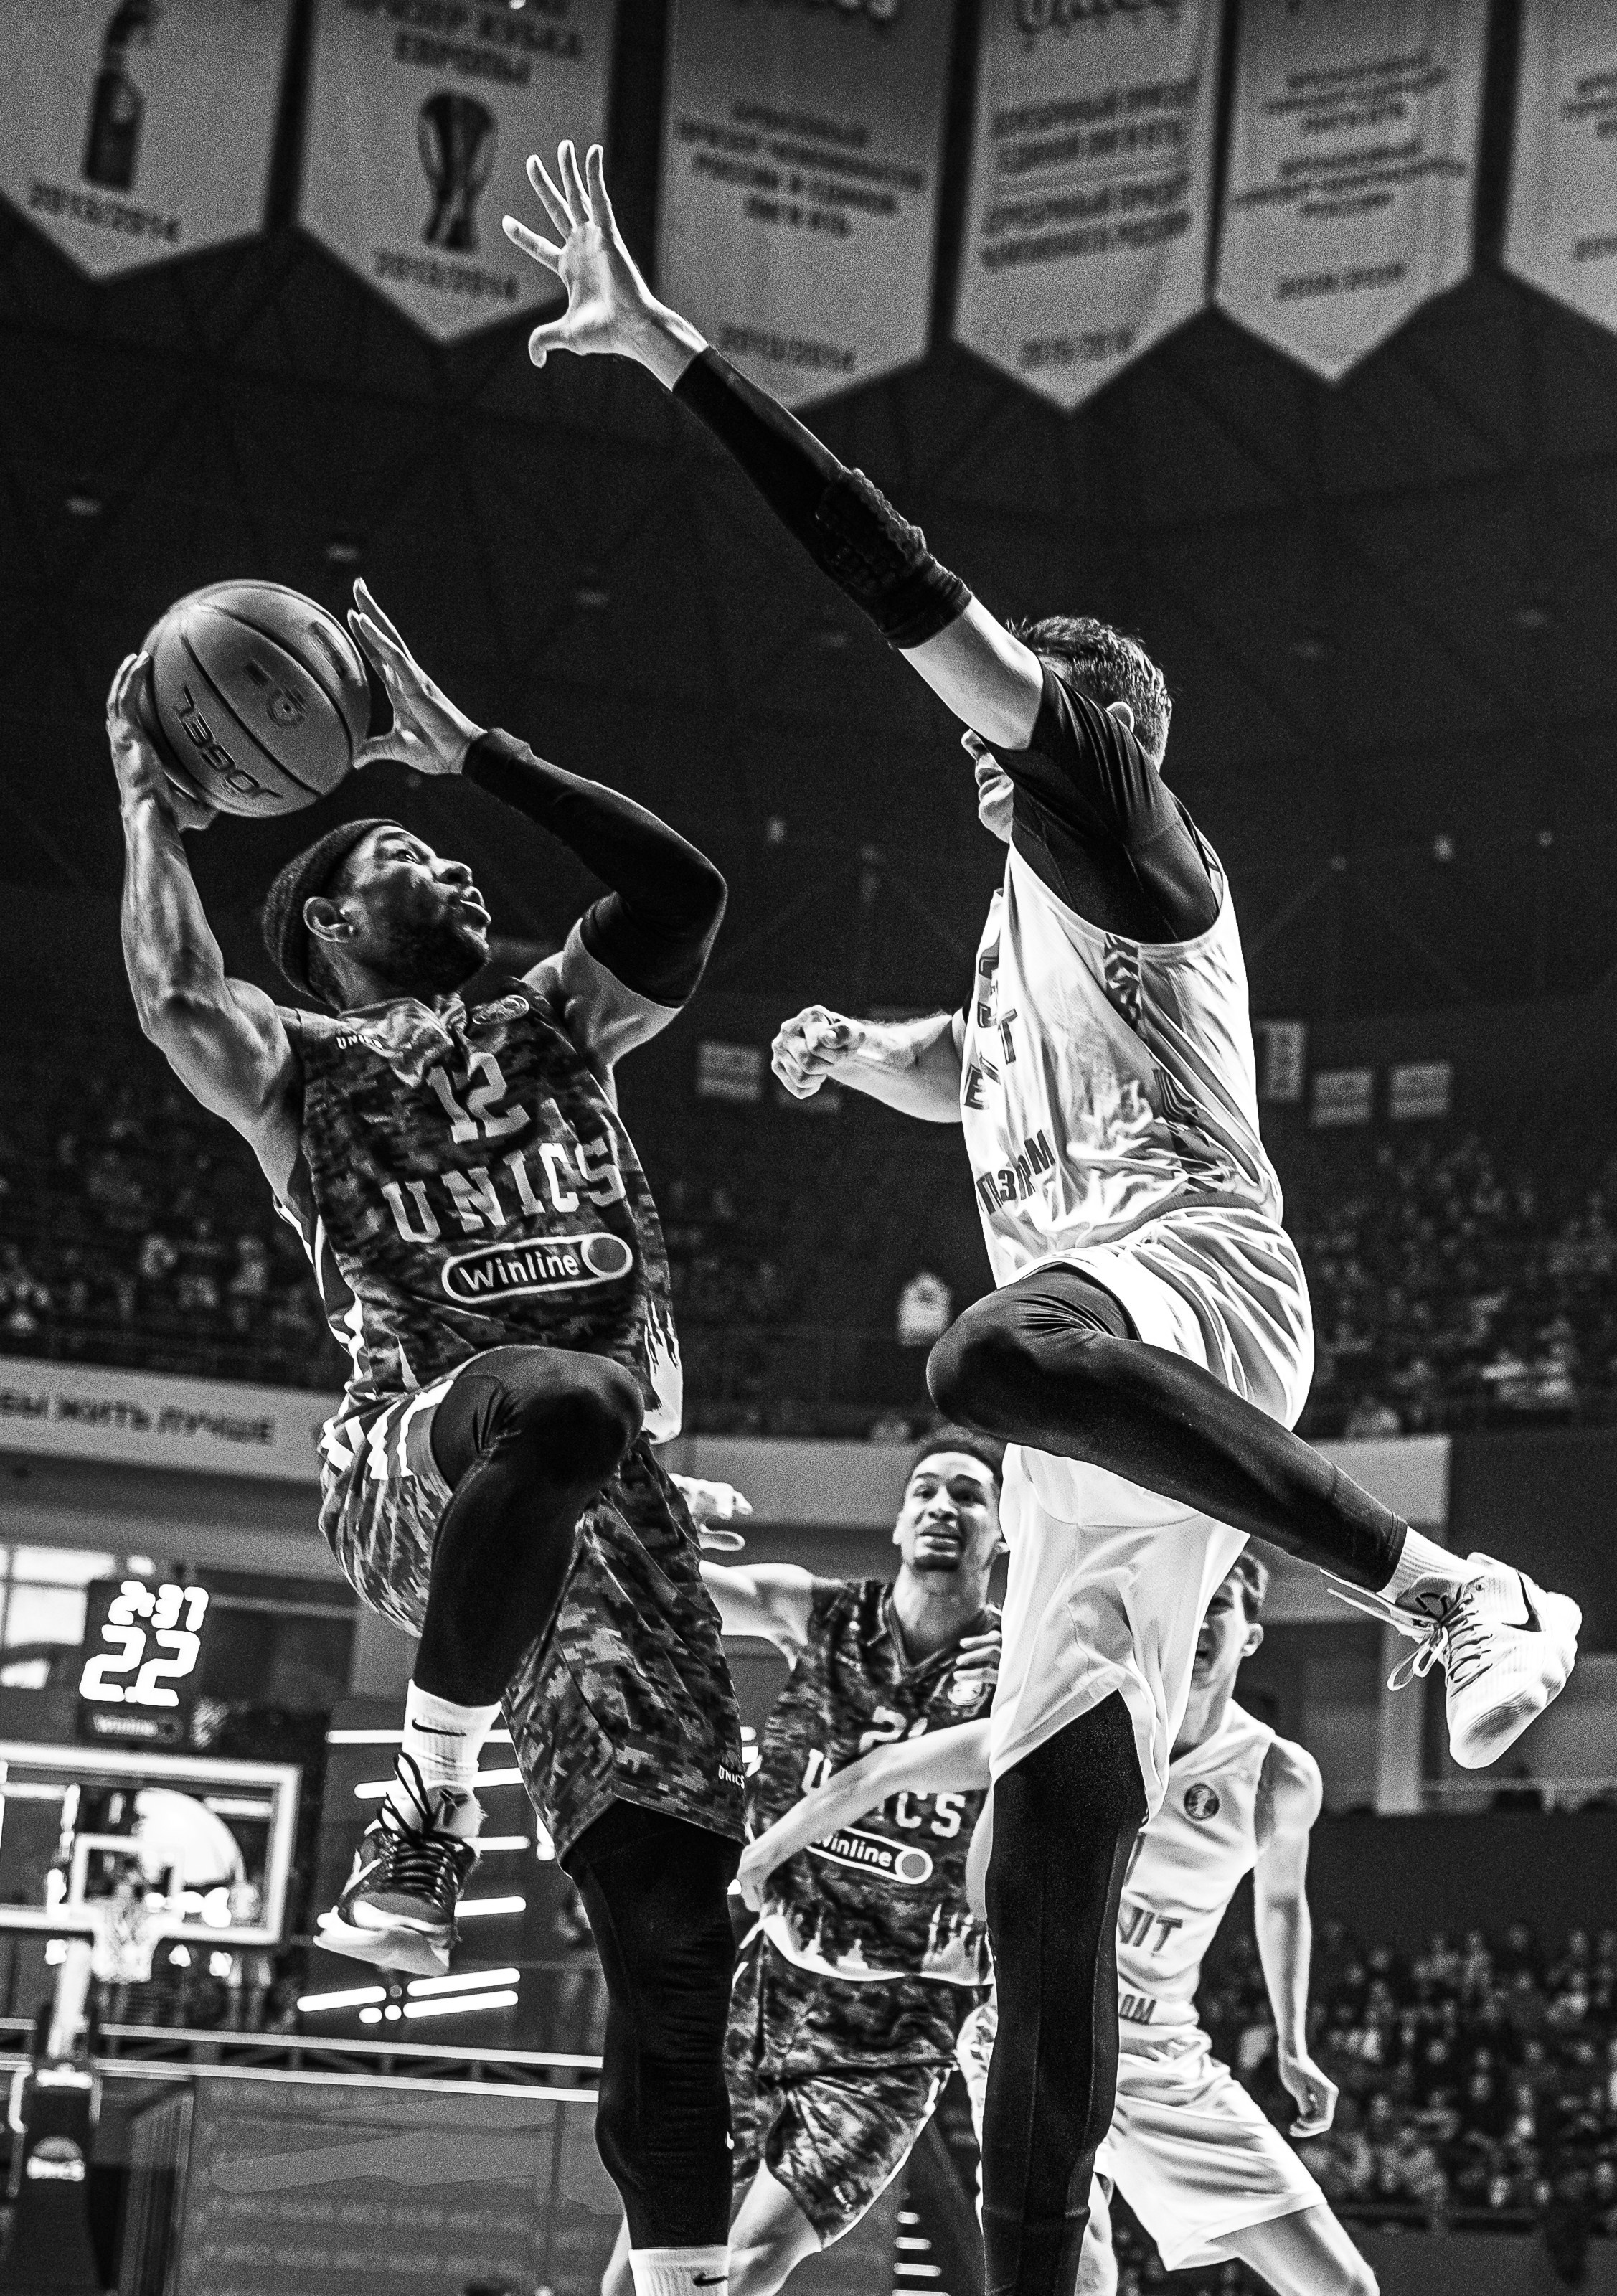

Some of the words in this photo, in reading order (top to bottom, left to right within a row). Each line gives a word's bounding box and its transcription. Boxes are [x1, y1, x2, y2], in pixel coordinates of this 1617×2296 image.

[426, 1052, 532, 1143] 12
[382, 1137, 626, 1243] UNICS
[458, 1252, 580, 1291] Winline
[801, 1748, 966, 1838] UCS
